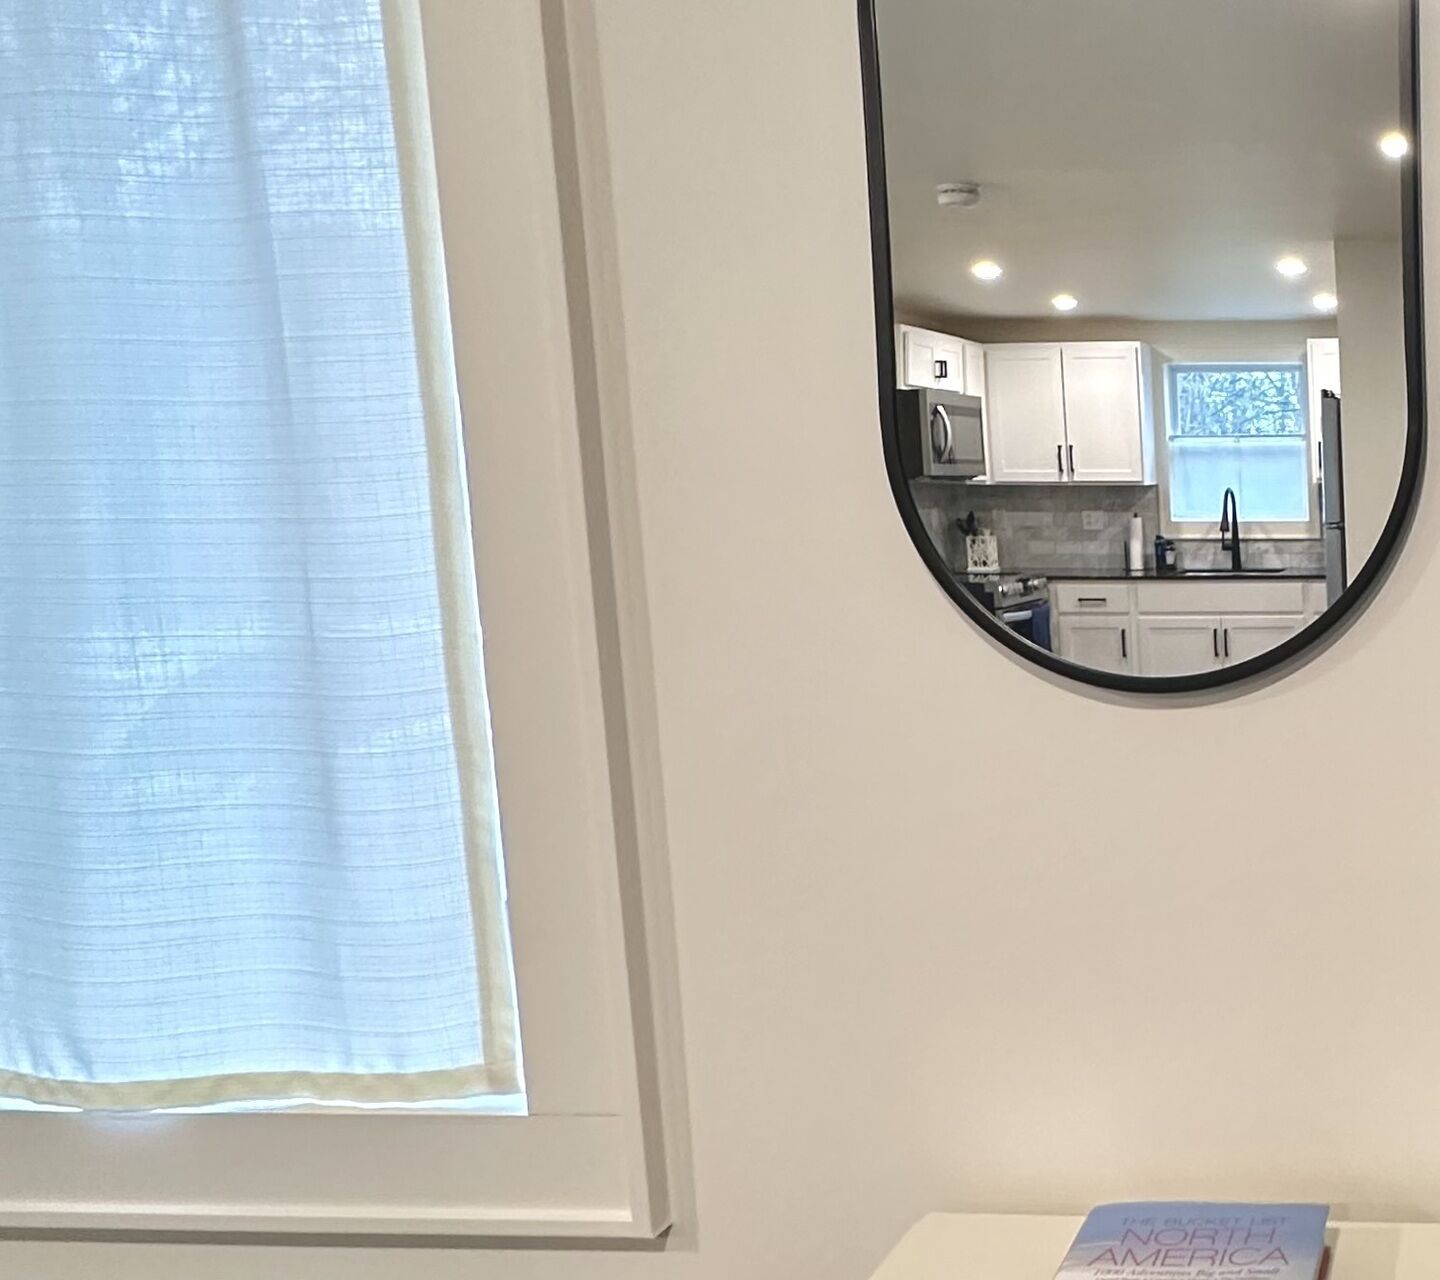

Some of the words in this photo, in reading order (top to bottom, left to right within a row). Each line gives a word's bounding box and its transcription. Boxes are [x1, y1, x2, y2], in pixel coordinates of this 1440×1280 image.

[1122, 1217, 1156, 1225] THE
[1163, 1217, 1241, 1225] BUCKET
[1249, 1216, 1288, 1225] LIST
[1121, 1227, 1277, 1247] NORTH
[1087, 1247, 1289, 1267] AMERICA
